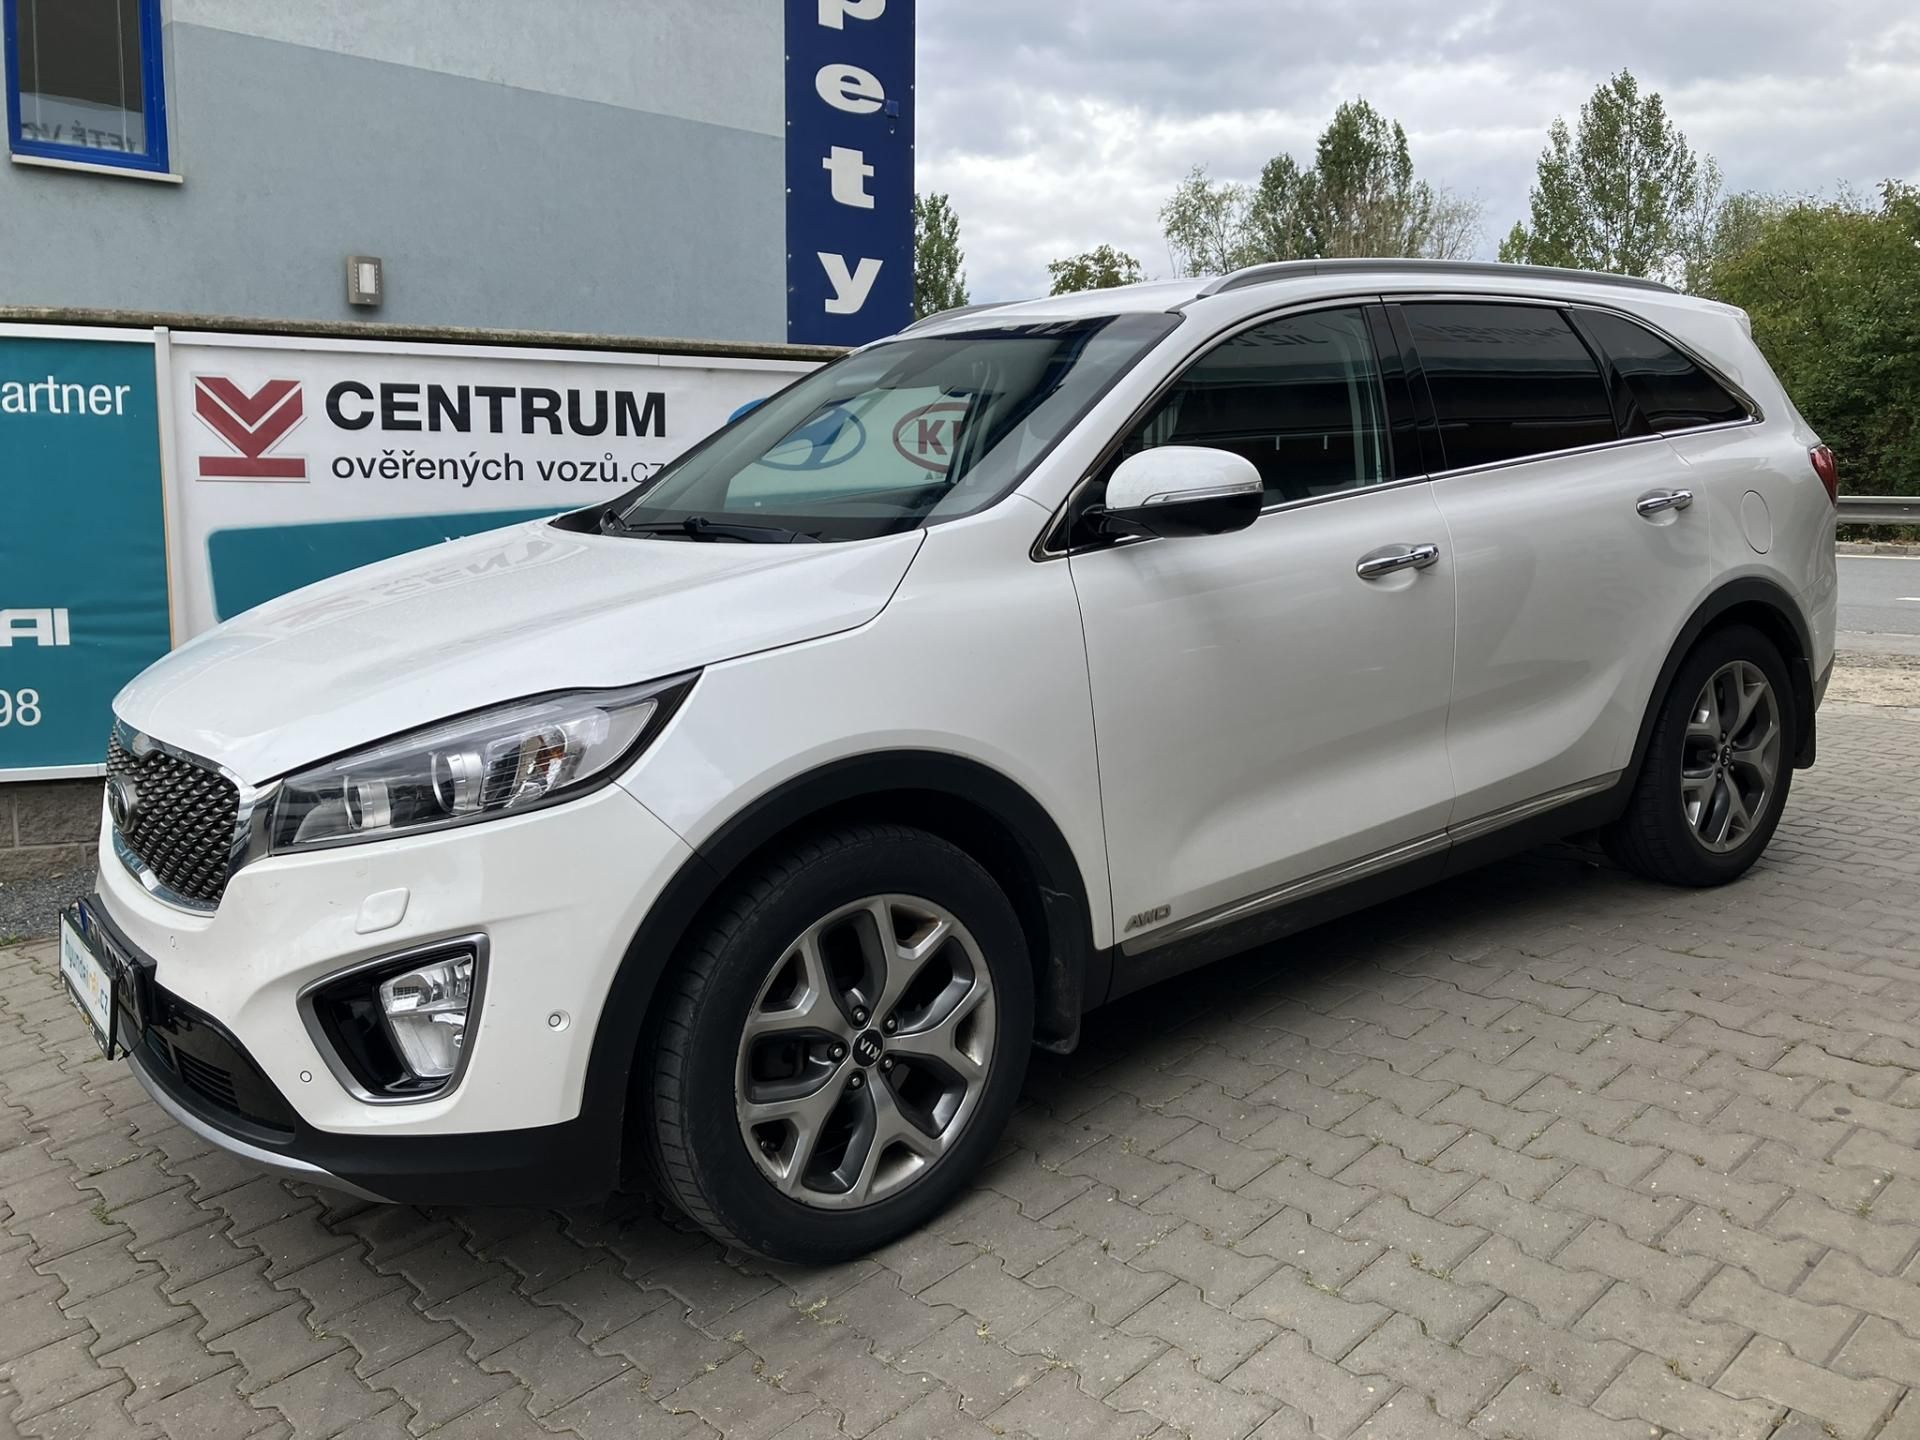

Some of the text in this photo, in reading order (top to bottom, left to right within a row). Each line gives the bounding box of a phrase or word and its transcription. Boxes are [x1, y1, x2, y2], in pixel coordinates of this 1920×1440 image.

[1, 375, 131, 416] artner
[325, 380, 666, 438] CENTRUM
[331, 449, 524, 488] ověřených
[1123, 903, 1172, 934] AWD
[860, 1038, 881, 1060] KIA
